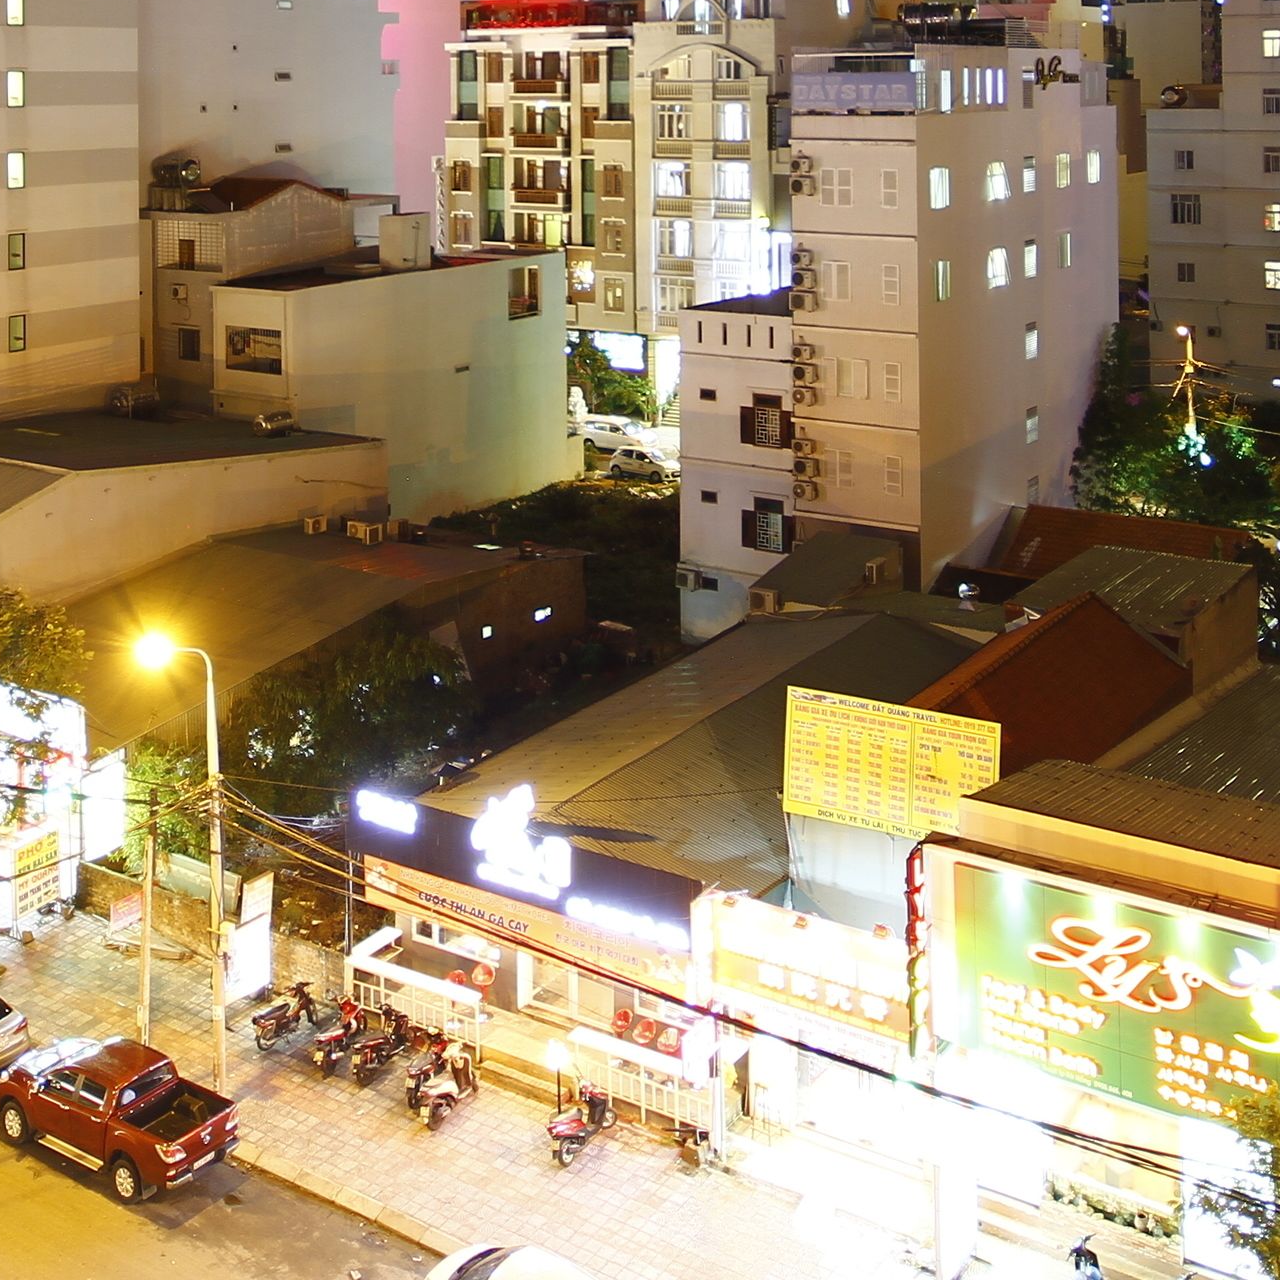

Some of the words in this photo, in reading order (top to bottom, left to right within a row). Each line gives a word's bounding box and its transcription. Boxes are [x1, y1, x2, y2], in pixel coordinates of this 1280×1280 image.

[793, 84, 908, 100] DAYSTAR
[912, 712, 938, 723] TRAVEL
[508, 919, 529, 933] CAY
